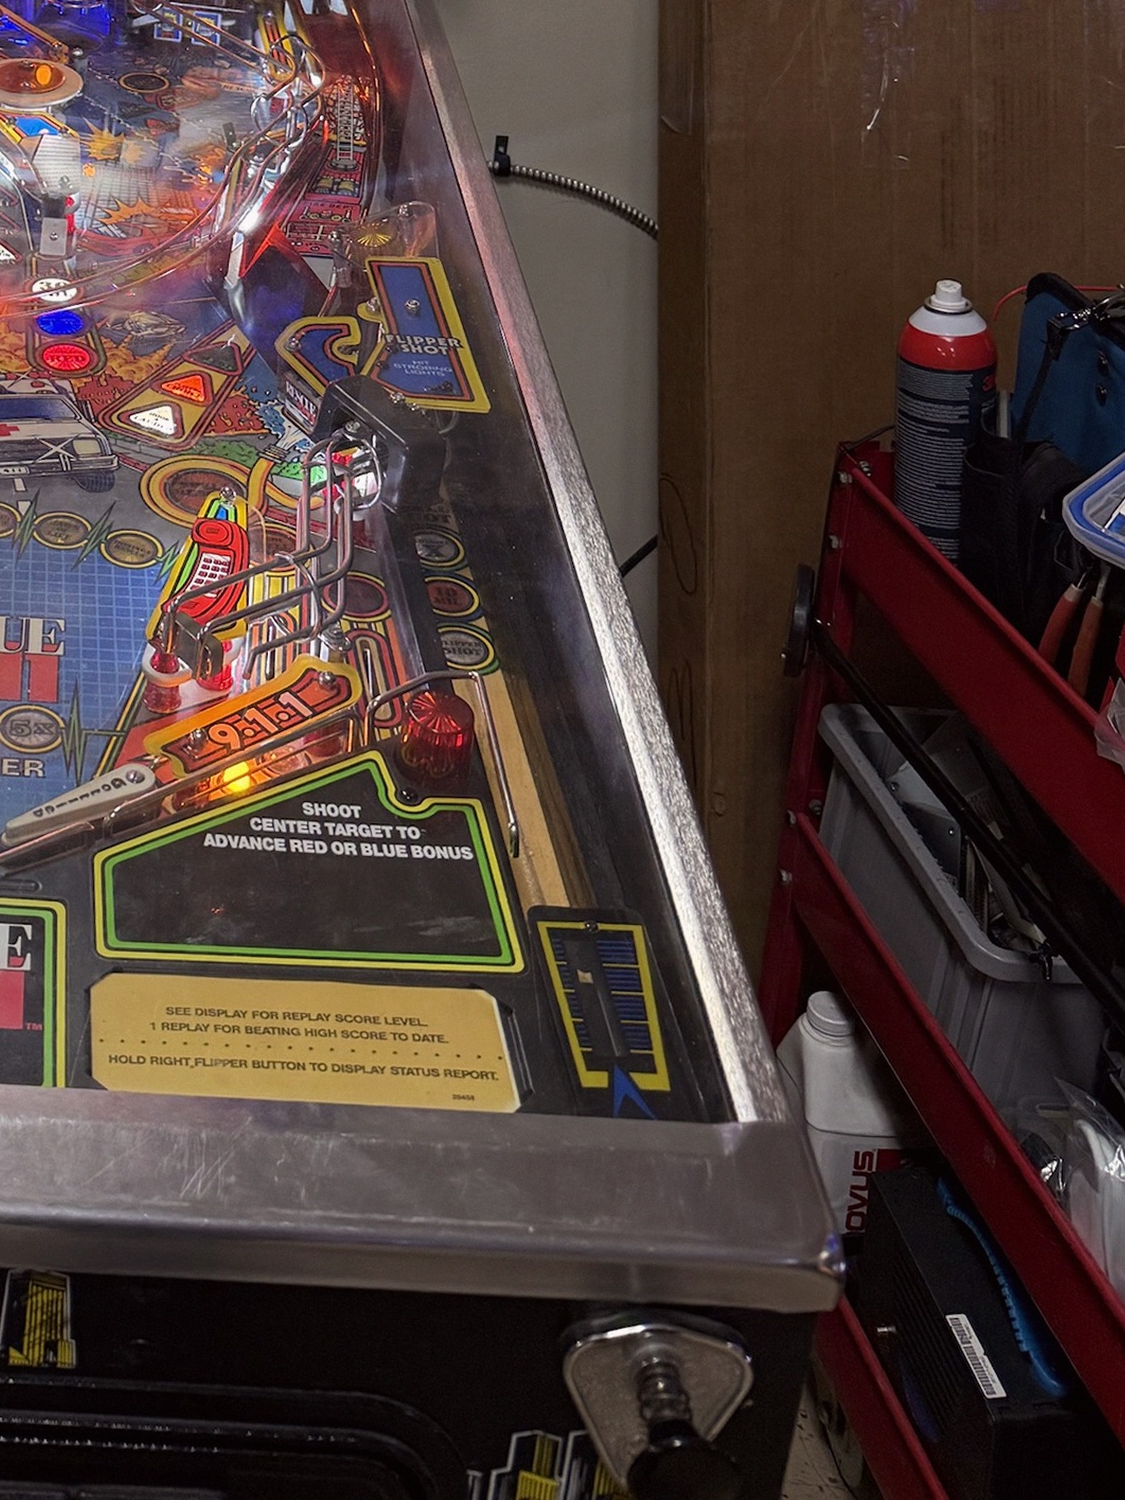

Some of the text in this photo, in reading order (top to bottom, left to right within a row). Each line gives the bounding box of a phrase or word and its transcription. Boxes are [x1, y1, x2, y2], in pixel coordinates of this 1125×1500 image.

[385, 335, 459, 347] FLIPPER
[400, 344, 448, 355] SHOT
[302, 802, 361, 819] SHOOT
[250, 817, 421, 839] CENTER TARGET TO
[204, 833, 474, 860] ADVANCE RED OR BLUE BONUS
[166, 1007, 428, 1027] SEE DISPLAY FOR REPLAY SCORE LEVEL.
[161, 1022, 210, 1032] REPLAY
[214, 1024, 241, 1034] FOR
[245, 1026, 301, 1036] BEATING
[305, 1028, 337, 1038] HIGH
[341, 1029, 387, 1040] SCORE
[390, 1032, 408, 1041] TO
[412, 1033, 449, 1044] DATE.
[108, 1054, 499, 1081] HOLD RIGHT FLIPPER BUTTON TO DISPLAY STATUS REPORT.
[845, 1150, 875, 1231] OVUS
